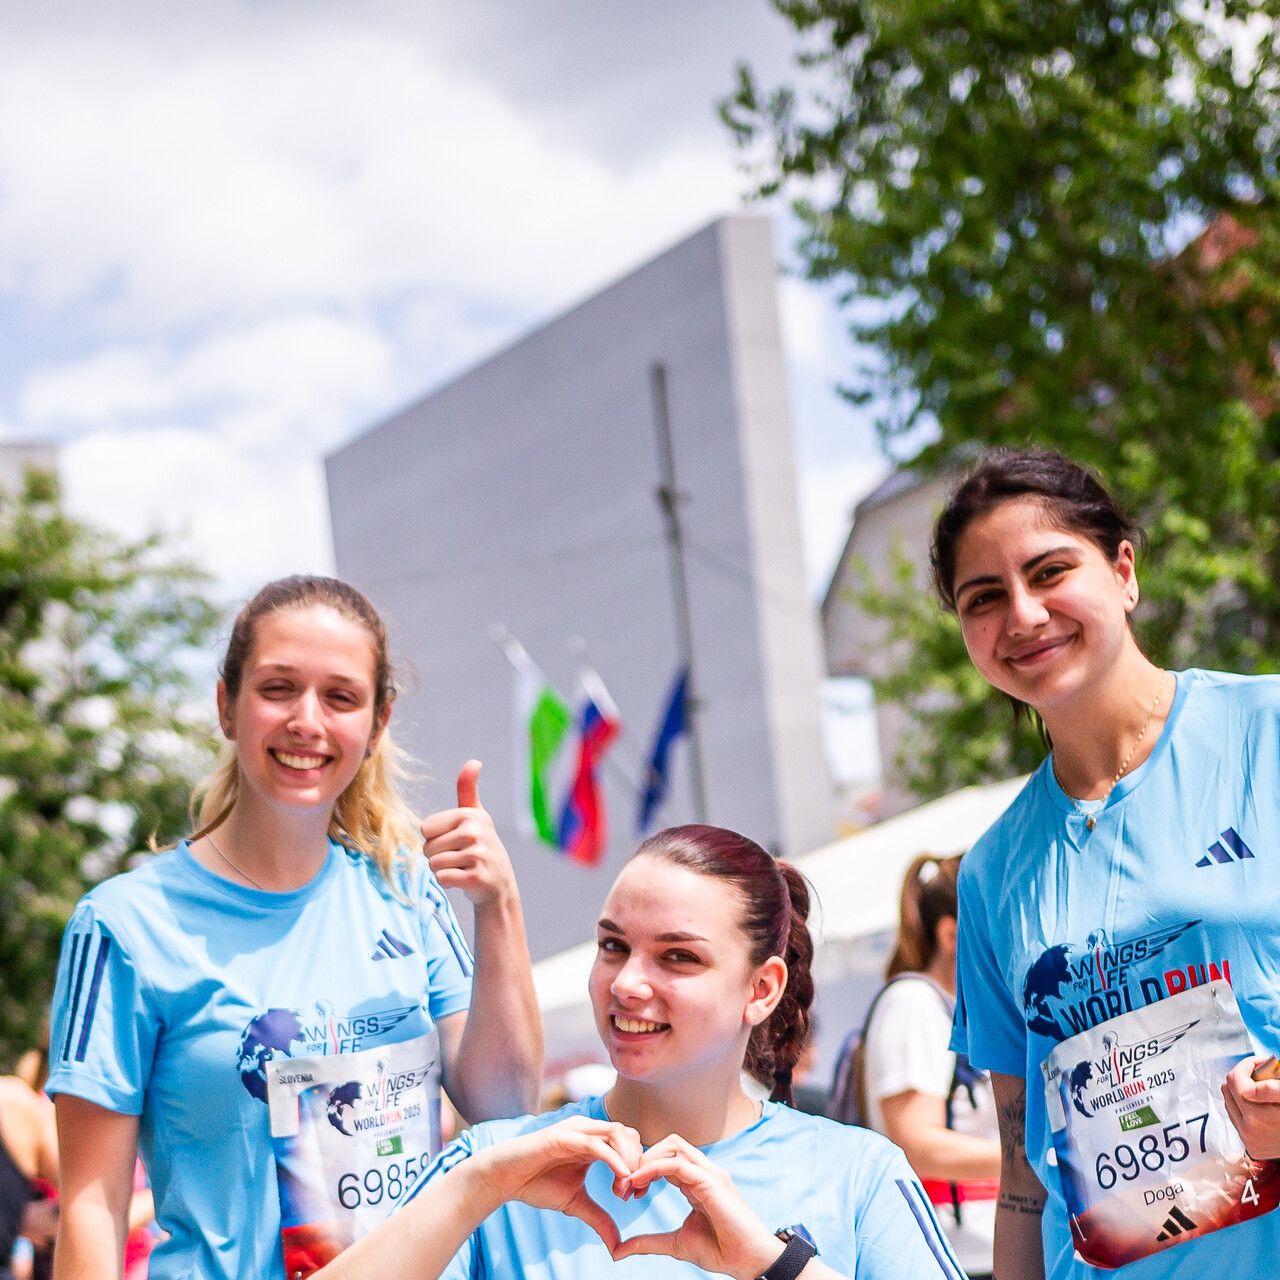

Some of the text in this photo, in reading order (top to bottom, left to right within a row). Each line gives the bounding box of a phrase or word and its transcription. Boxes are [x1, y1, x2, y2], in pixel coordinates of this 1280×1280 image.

[1071, 939, 1148, 980] WINGS
[1072, 979, 1088, 992] FOR
[305, 1016, 380, 1041] WINGS
[1095, 1039, 1159, 1075] WINGS
[279, 1073, 314, 1085] SLOVENIA
[1109, 1062, 1143, 1088] LIFE
[1090, 1069, 1176, 1111] WORLD RUN 2025
[353, 1113, 385, 1132] WORLD
[403, 1104, 422, 1121] 2025
[1095, 1113, 1210, 1190] 69857
[1143, 1183, 1185, 1206] Doga
[1241, 1178, 1260, 1206] 4
